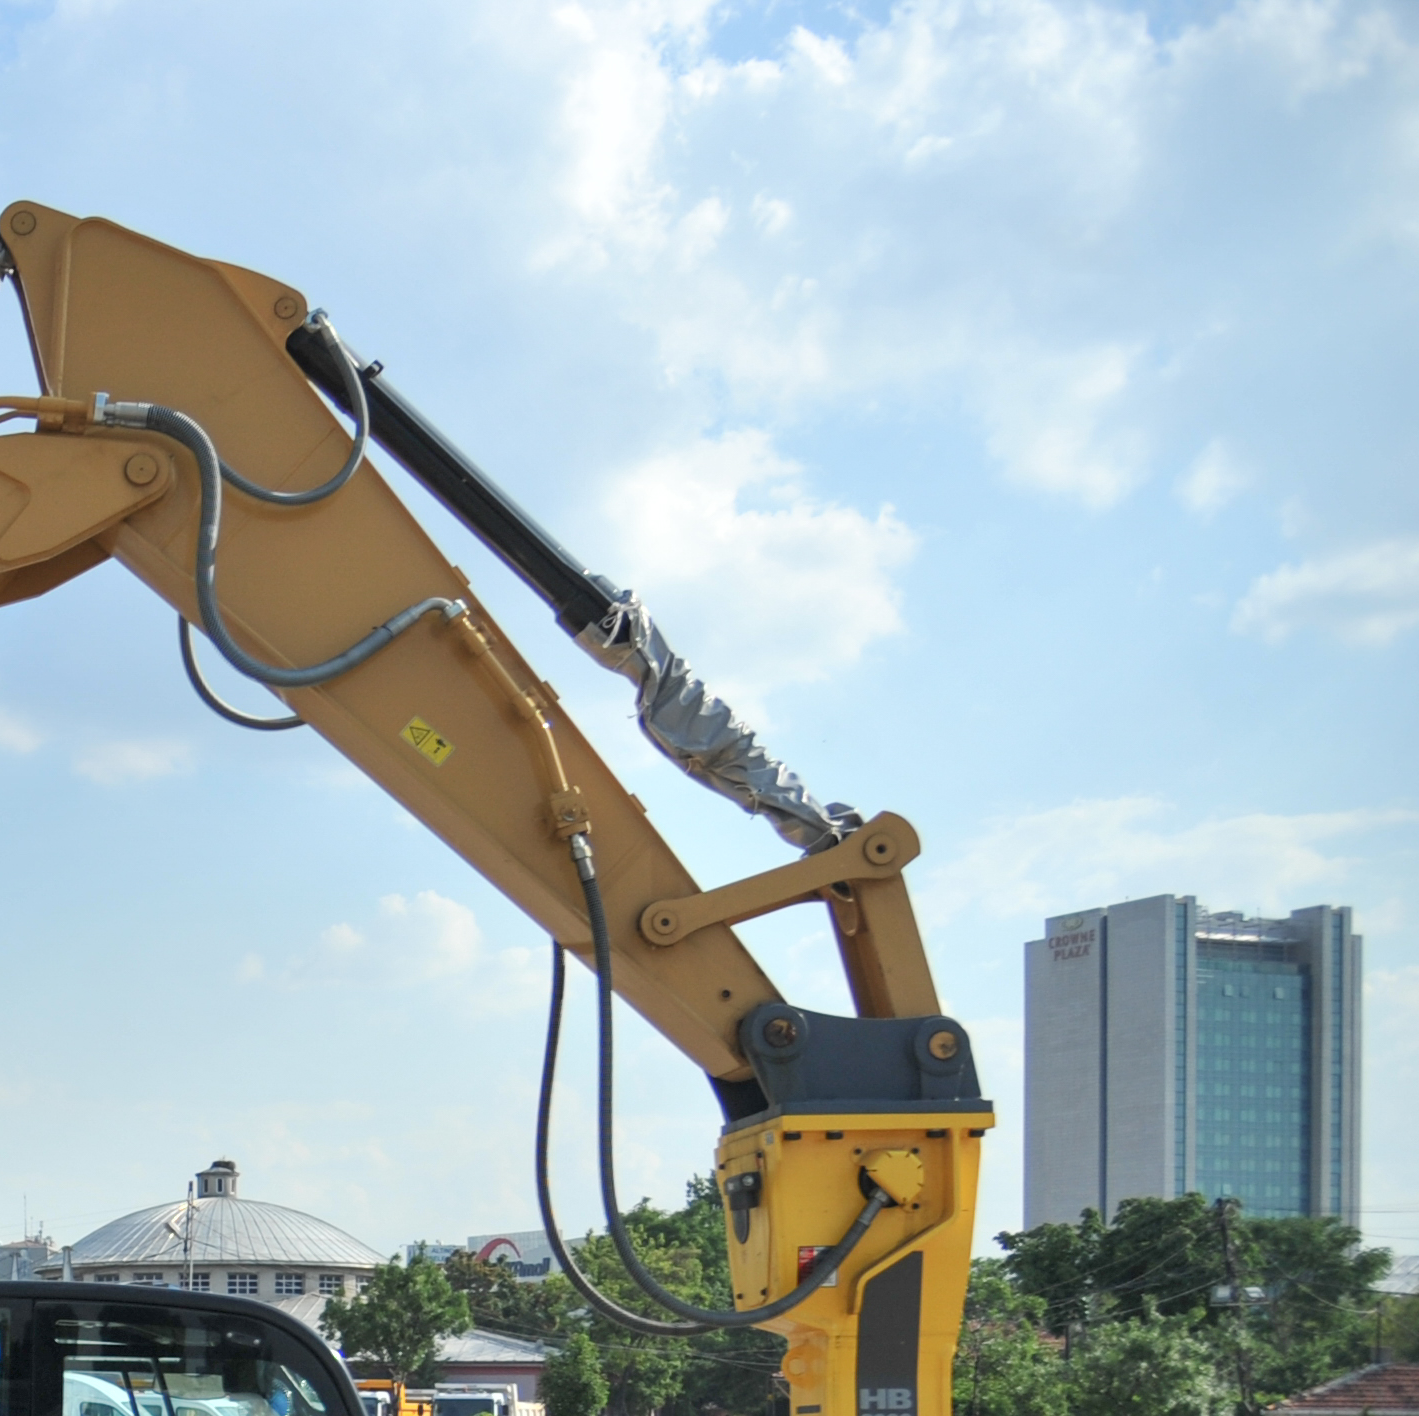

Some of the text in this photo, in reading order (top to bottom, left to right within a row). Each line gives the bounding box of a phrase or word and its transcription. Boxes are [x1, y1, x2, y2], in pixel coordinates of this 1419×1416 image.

[1048, 929, 1095, 949] CROWNE
[1054, 944, 1091, 961] PLAZA
[859, 1388, 912, 1410] HB
